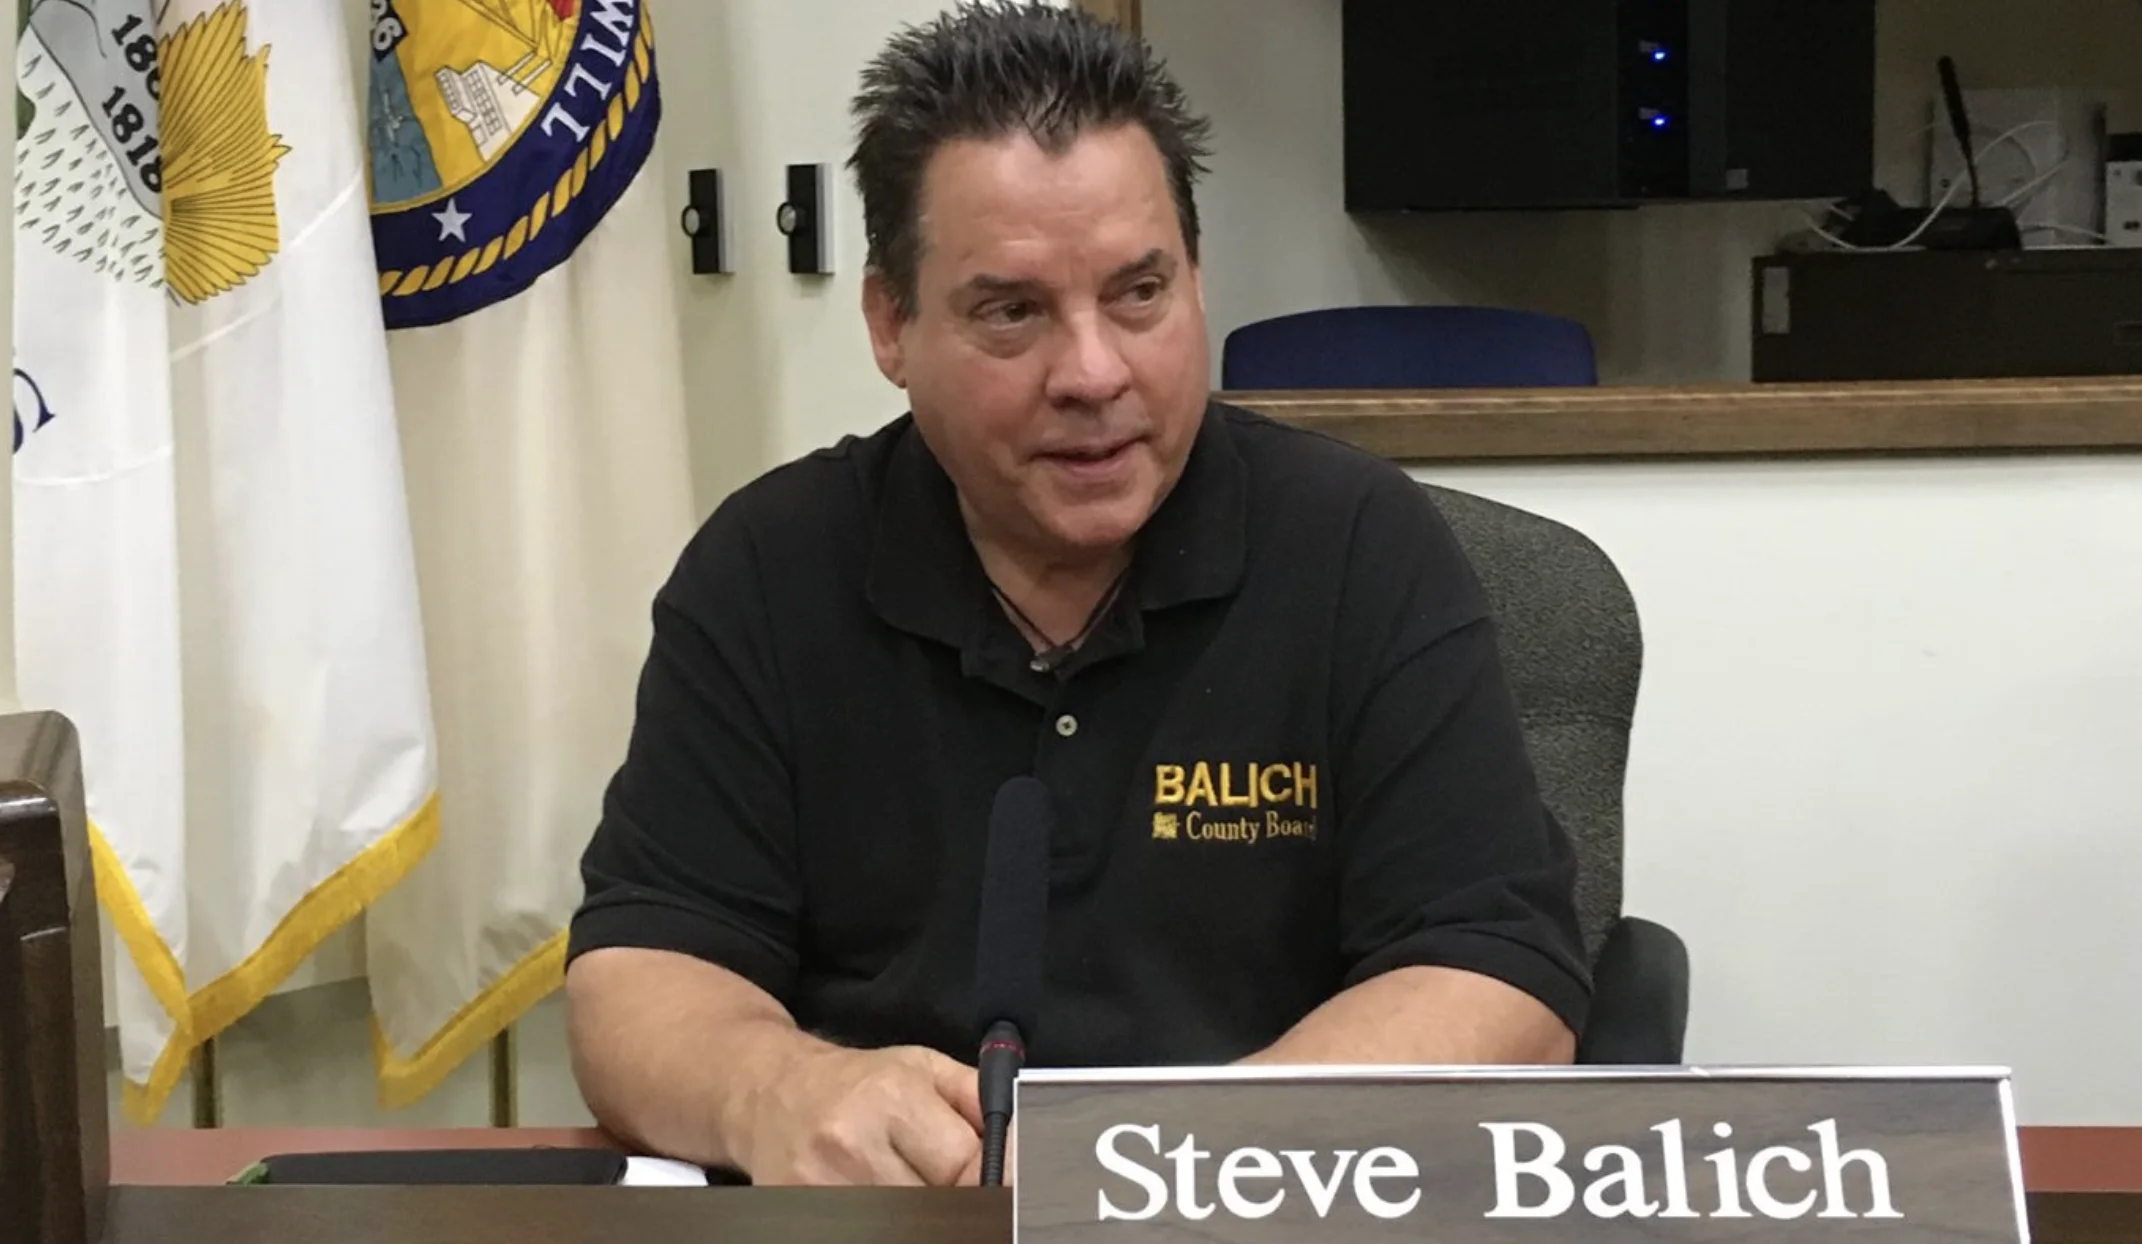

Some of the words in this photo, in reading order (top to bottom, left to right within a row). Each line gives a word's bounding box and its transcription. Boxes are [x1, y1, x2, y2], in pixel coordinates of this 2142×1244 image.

[540, 0, 634, 143] WILL
[1154, 761, 1318, 809] BALICH
[1186, 811, 1260, 844] County
[1094, 1122, 1422, 1221] Steve
[1478, 1117, 1905, 1220] Balich
